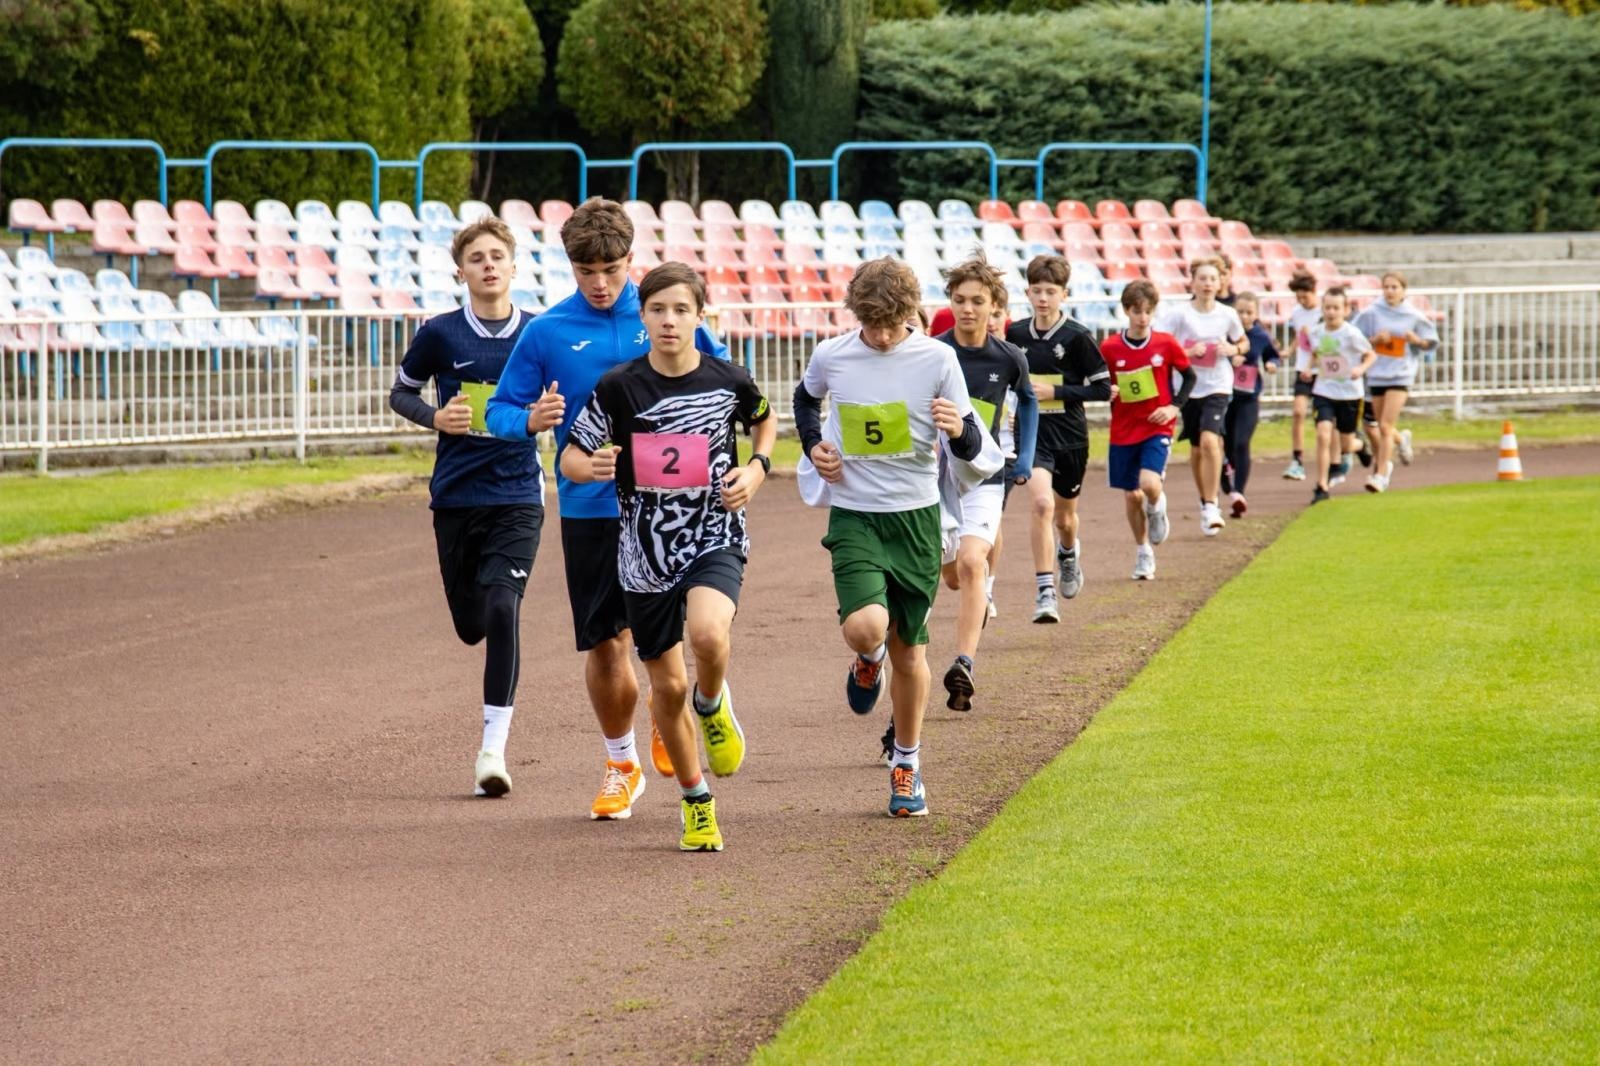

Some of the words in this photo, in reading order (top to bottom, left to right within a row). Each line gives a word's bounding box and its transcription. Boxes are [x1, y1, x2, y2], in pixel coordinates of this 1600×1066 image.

[1326, 360, 1339, 372] 10
[1130, 381, 1141, 395] 8
[865, 421, 883, 445] 5
[661, 447, 680, 474] 2
